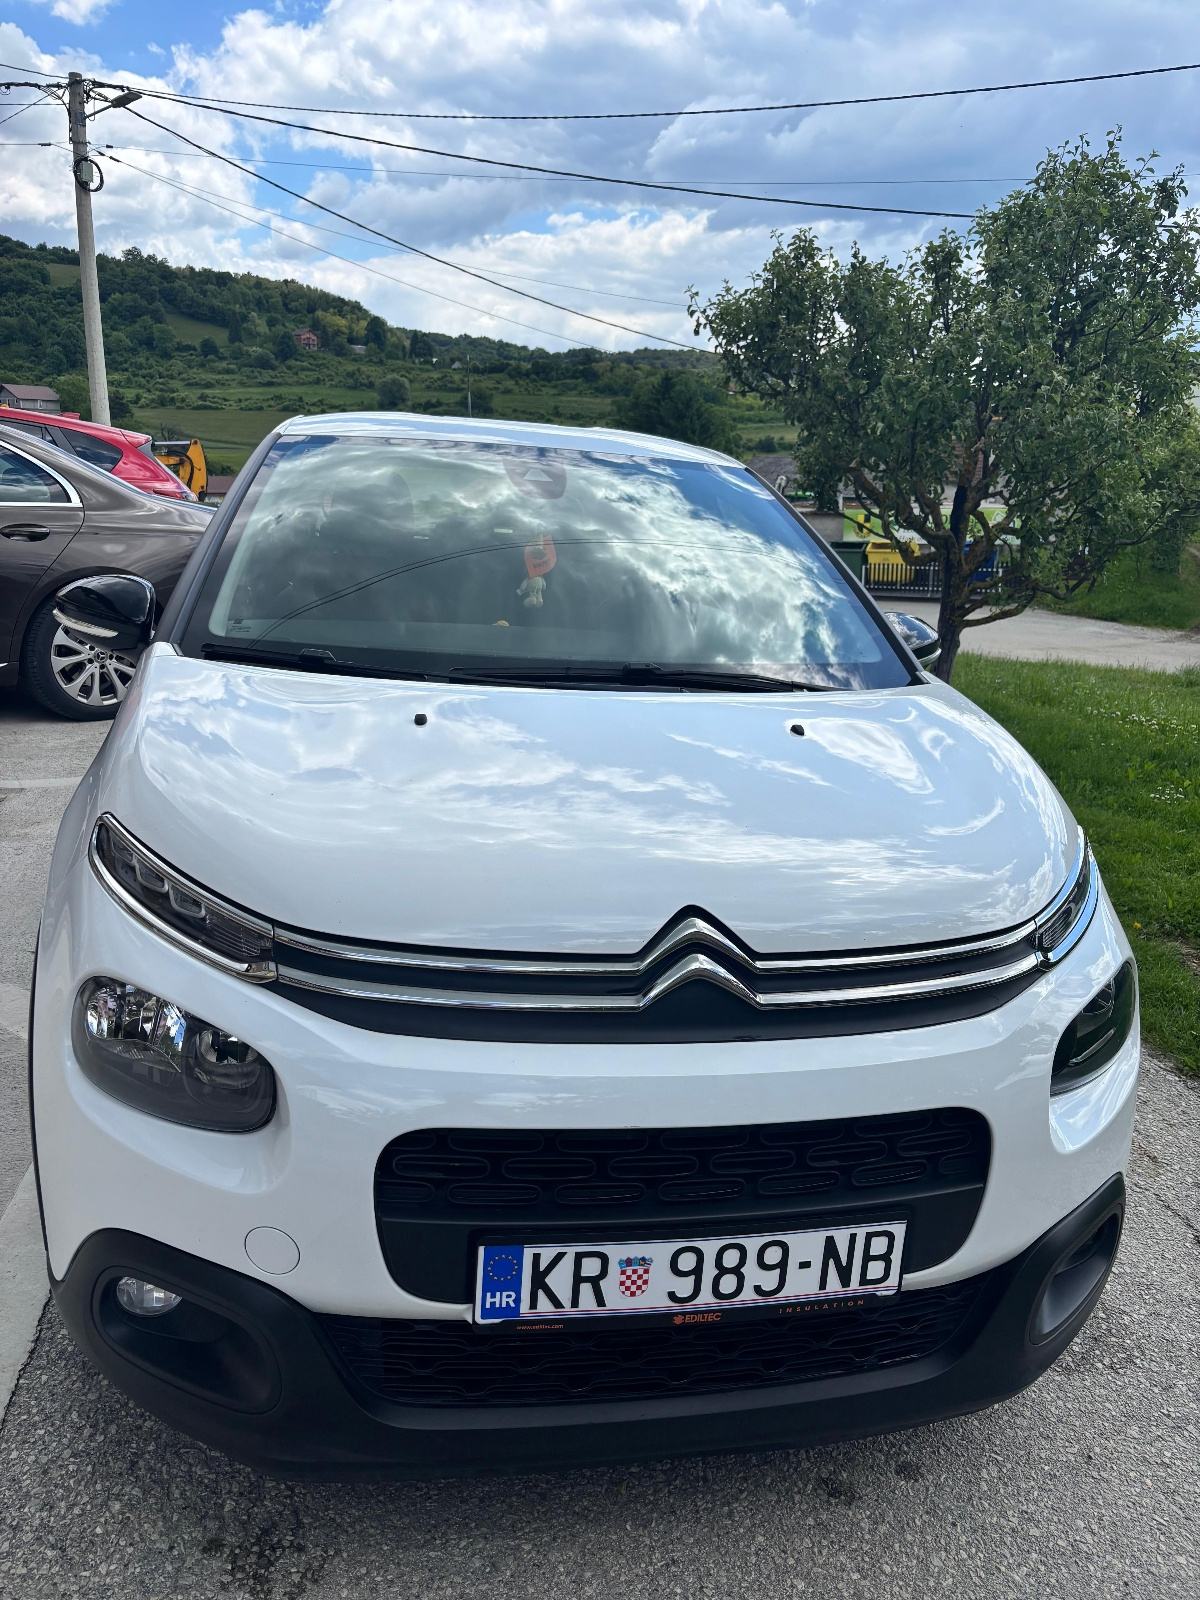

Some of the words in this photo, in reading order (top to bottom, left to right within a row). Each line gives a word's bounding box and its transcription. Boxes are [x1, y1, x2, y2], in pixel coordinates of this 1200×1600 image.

[528, 1250, 610, 1310] KR
[667, 1229, 896, 1304] 989-NB
[485, 1291, 517, 1309] HR
[779, 1299, 865, 1314] INSULATION
[684, 1312, 722, 1324] EDILTEC
